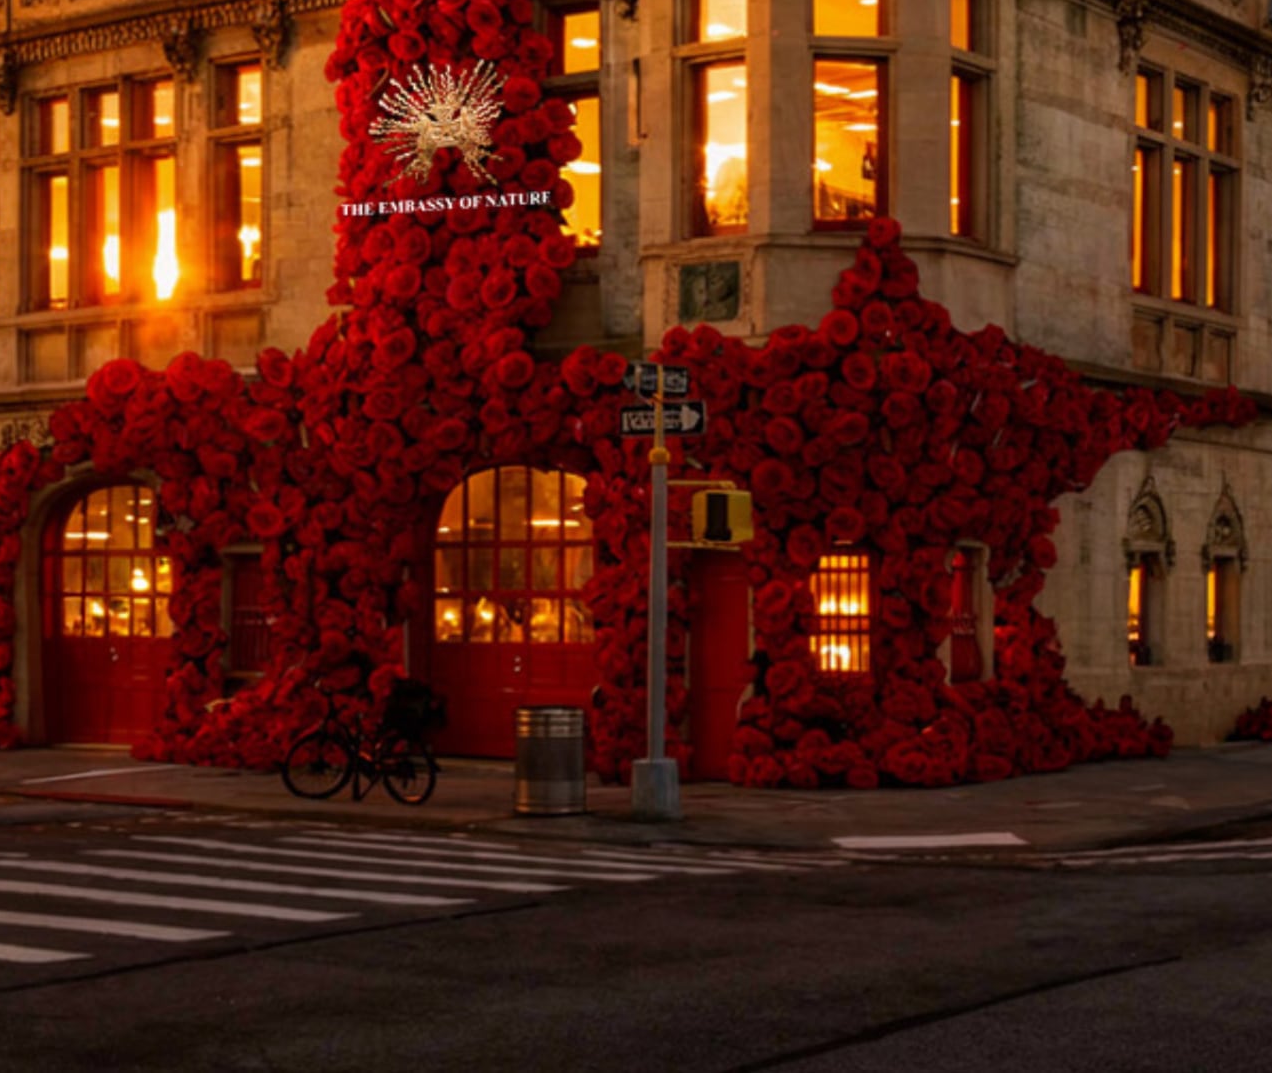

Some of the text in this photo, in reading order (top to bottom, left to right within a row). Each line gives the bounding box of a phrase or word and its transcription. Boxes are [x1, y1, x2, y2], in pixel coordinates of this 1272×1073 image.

[341, 190, 551, 216] THE EMBASSY OF NATURE
